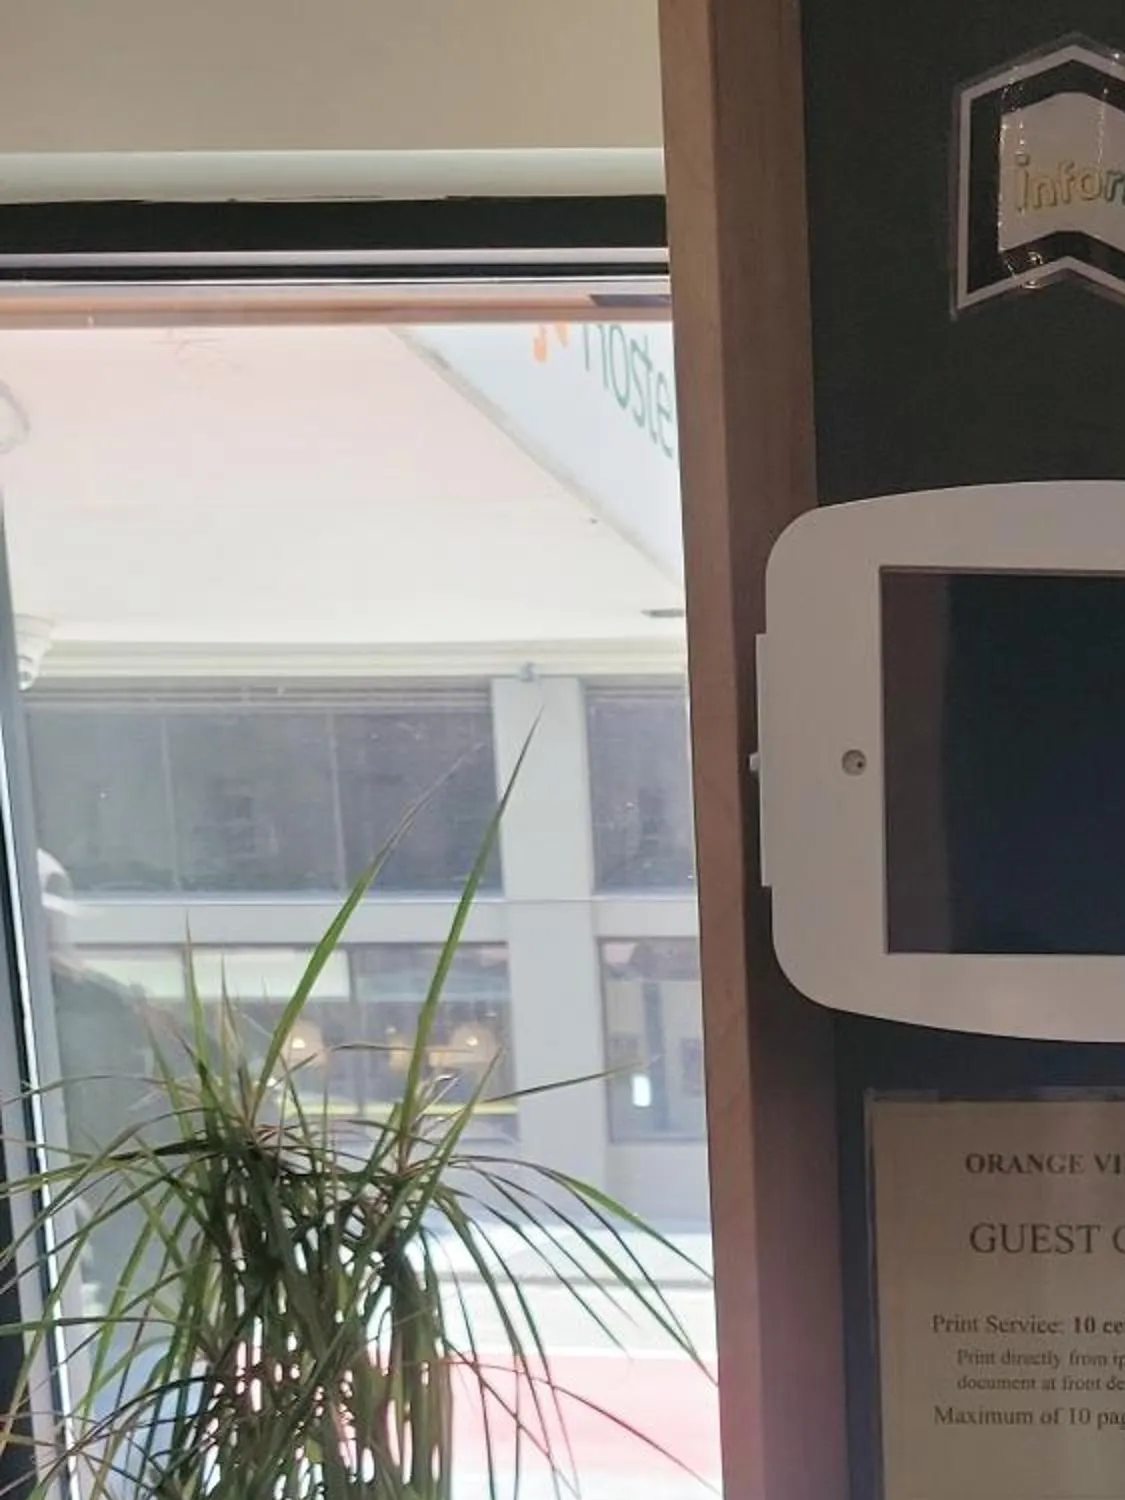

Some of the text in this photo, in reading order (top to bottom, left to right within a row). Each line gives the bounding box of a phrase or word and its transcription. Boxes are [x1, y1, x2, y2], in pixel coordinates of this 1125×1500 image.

[965, 1153, 1085, 1175] ORANGE
[969, 1222, 1100, 1254] GUEST
[932, 1314, 978, 1333] Print
[986, 1314, 1064, 1334] Service:
[1073, 1315, 1096, 1334] 10
[956, 1349, 995, 1366] Print
[1000, 1349, 1061, 1369] directly
[1068, 1350, 1108, 1366] from
[956, 1375, 1037, 1391] document
[1040, 1377, 1056, 1391] at
[1062, 1375, 1101, 1391] front
[933, 1405, 1034, 1425] Maximum
[1039, 1407, 1064, 1425] of
[1070, 1407, 1092, 1425] 10
